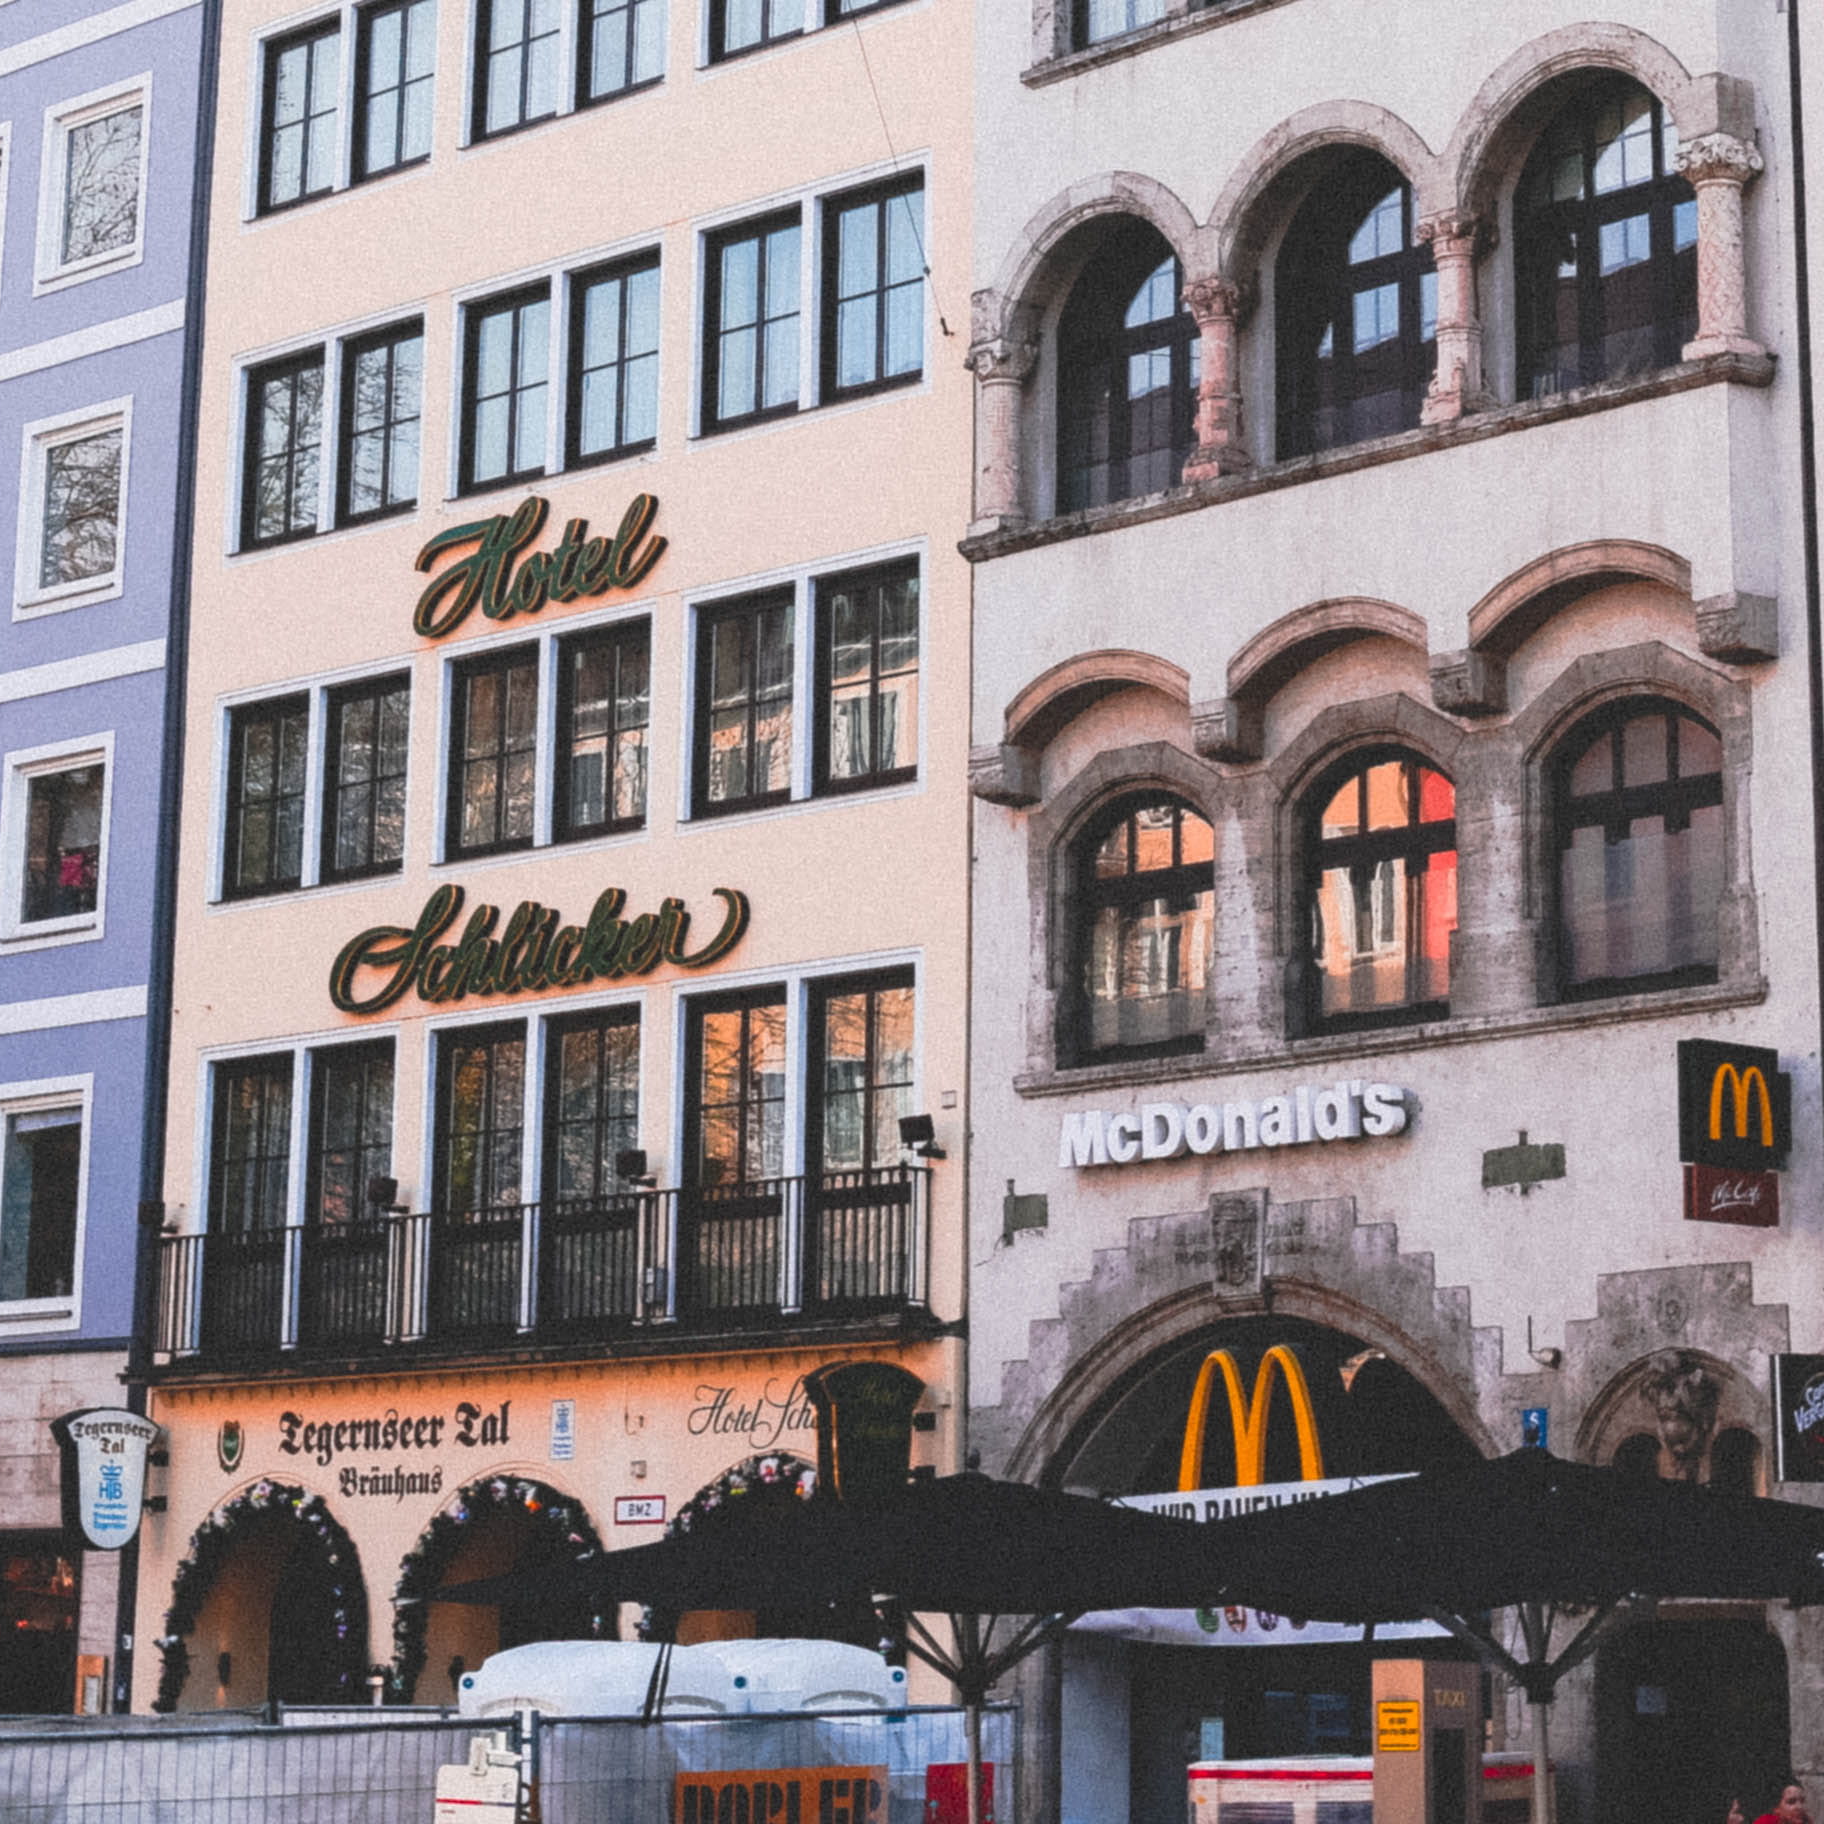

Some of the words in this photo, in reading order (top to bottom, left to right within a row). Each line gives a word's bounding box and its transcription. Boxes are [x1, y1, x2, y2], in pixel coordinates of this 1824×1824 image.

[413, 493, 668, 639] Hotel
[329, 884, 750, 1015] Schlicker
[1059, 1079, 1406, 1169] McDonald's
[279, 1409, 444, 1466] Tegernseer
[455, 1400, 512, 1447] Tal
[688, 1384, 762, 1435] Hotel
[339, 1465, 443, 1503] Bräuhaus
